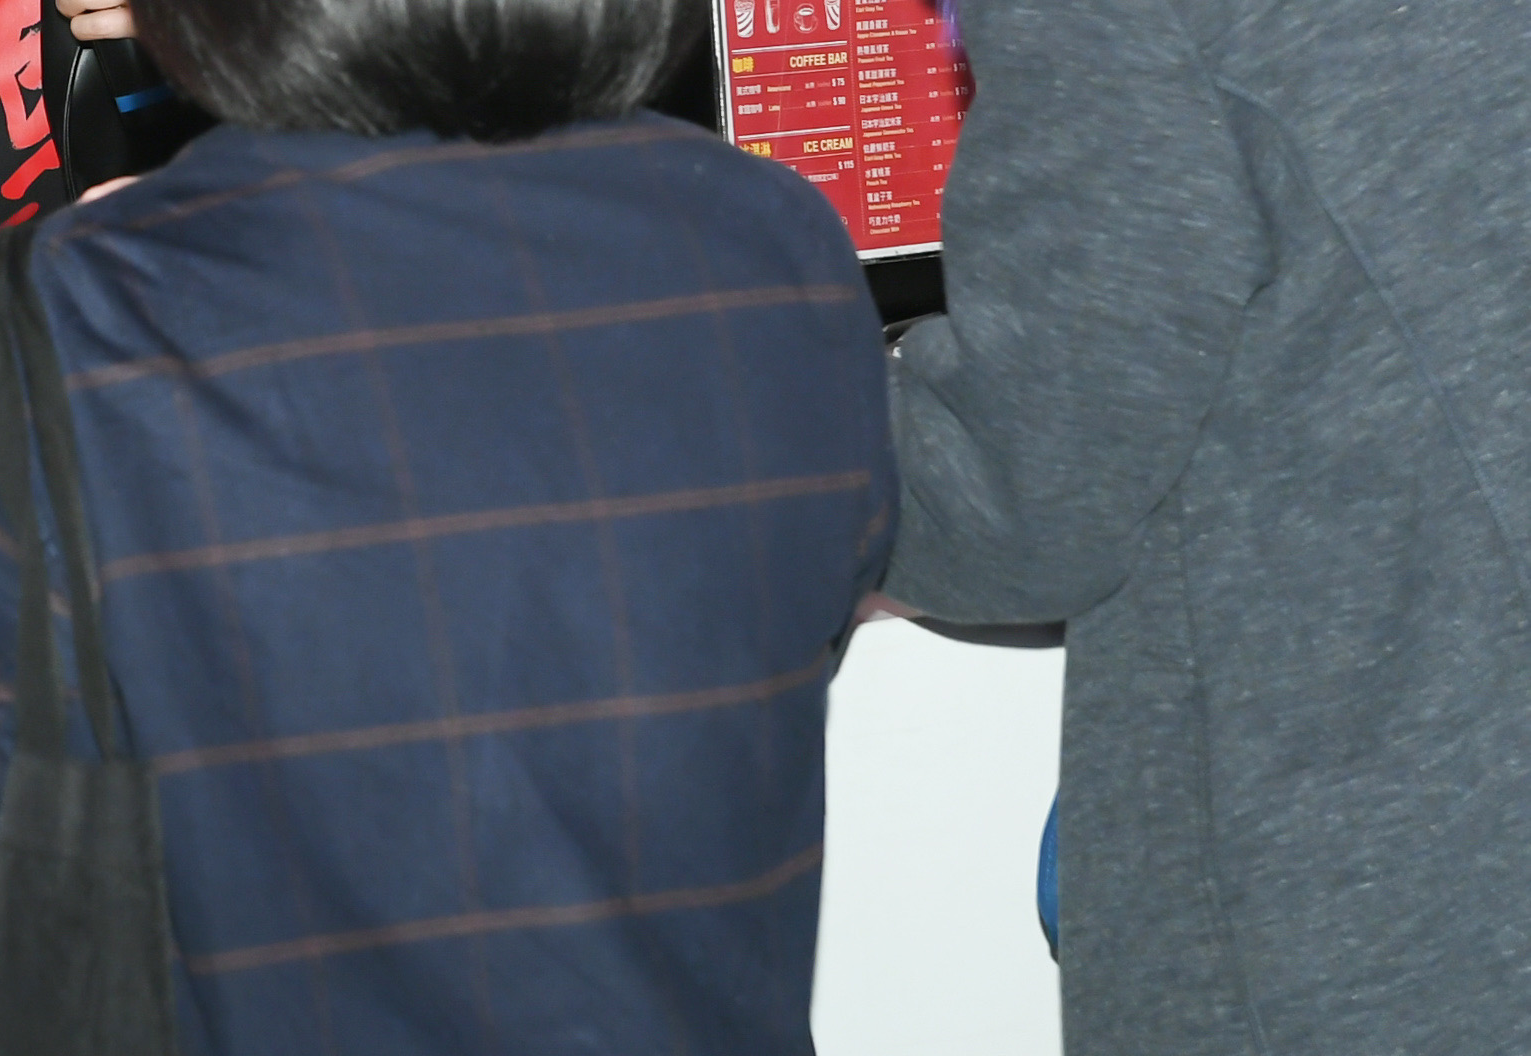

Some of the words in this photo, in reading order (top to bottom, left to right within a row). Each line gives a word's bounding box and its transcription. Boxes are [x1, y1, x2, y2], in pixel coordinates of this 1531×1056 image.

[790, 54, 826, 68] COFFEE
[828, 52, 848, 65] BAR
[803, 141, 819, 153] ICE
[820, 138, 853, 151] CREAM
